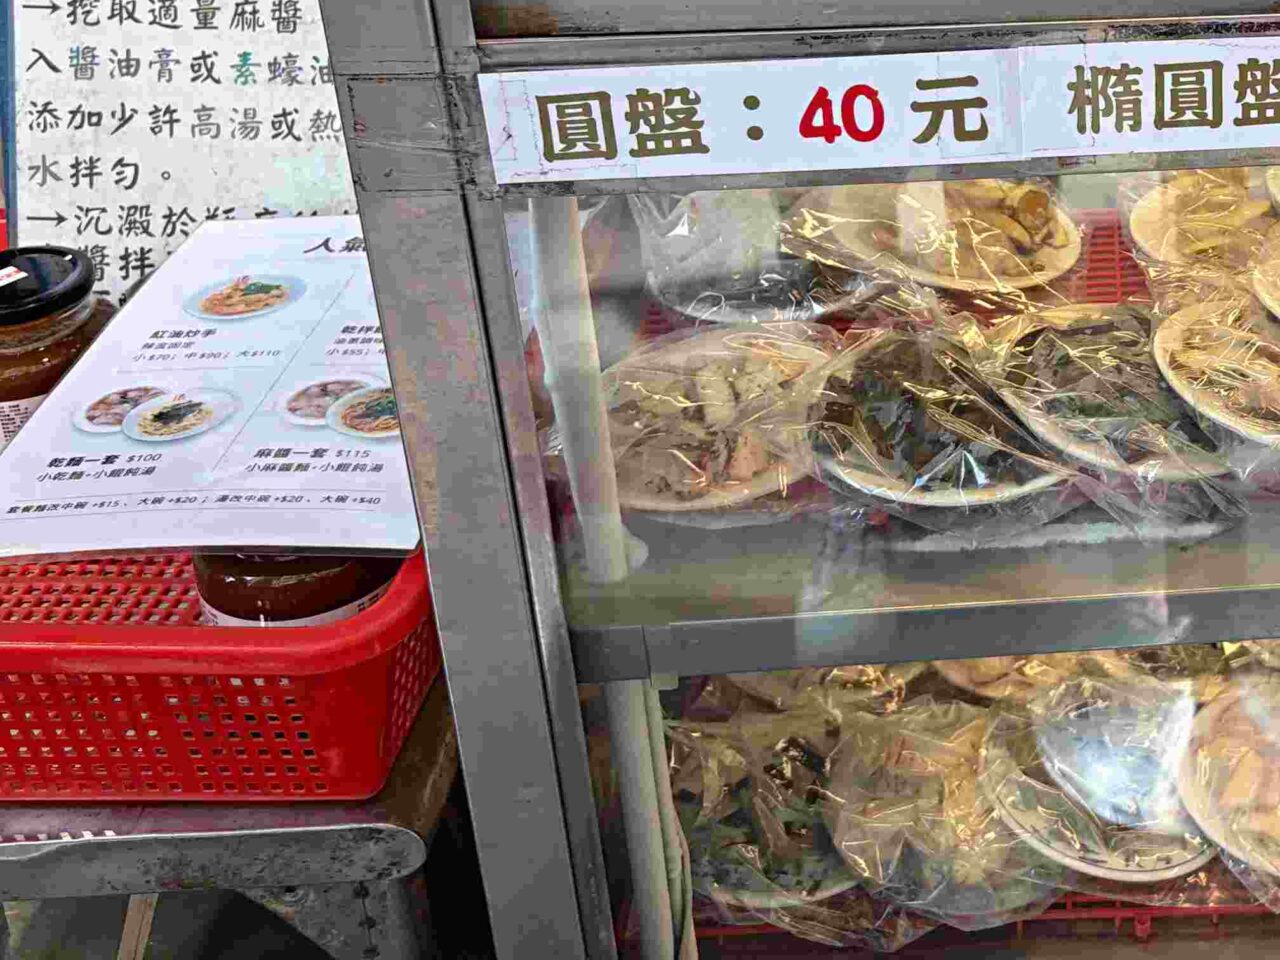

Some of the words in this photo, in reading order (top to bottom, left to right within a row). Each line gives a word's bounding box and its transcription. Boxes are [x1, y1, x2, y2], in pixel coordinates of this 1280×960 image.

[27, 101, 343, 143] 添加少許高湯或熱
